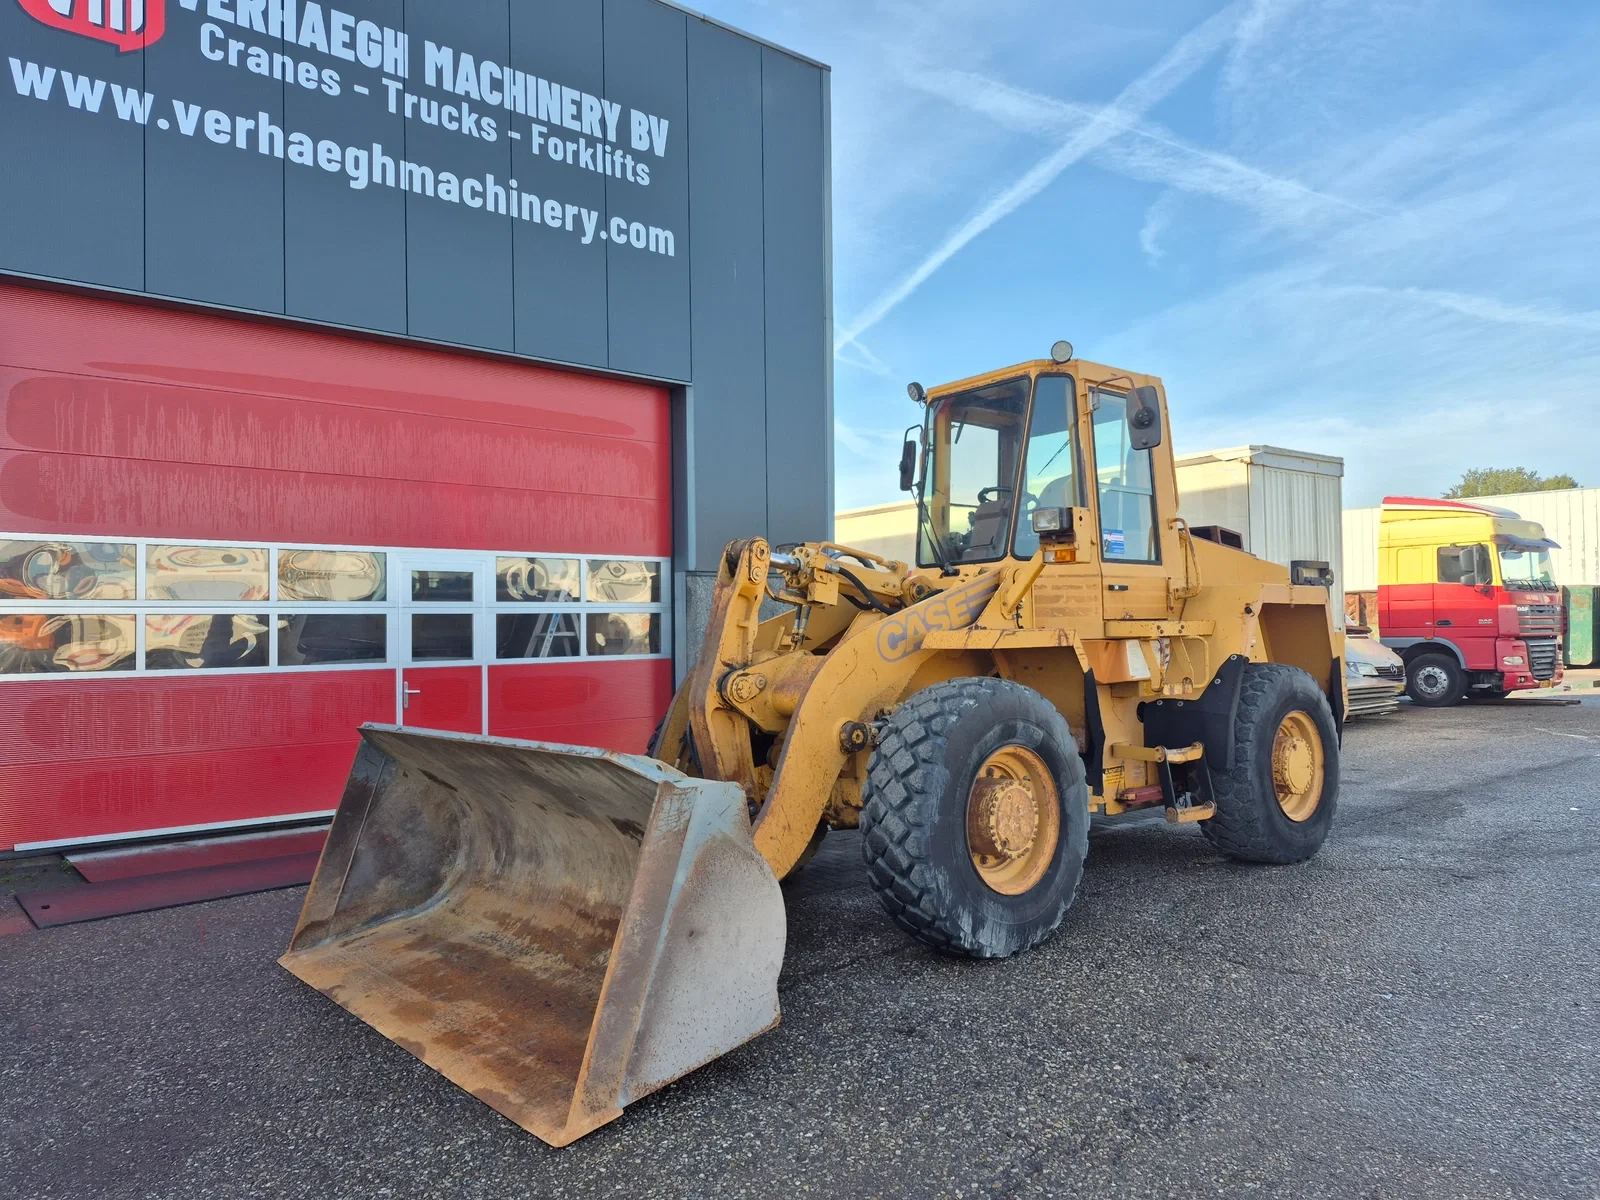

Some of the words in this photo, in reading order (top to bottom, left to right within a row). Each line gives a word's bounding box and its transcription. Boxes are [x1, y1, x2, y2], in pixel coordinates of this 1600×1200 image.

[8, 56, 675, 257] www.verhaeghmachinery.com
[179, 0, 409, 79] RHAEGH
[424, 40, 621, 142] MACHINERY
[630, 108, 669, 158] BV
[200, 22, 341, 96] Cranes
[382, 77, 498, 142] Trucks
[531, 123, 650, 186] Forklifts
[877, 591, 973, 663] CASE
